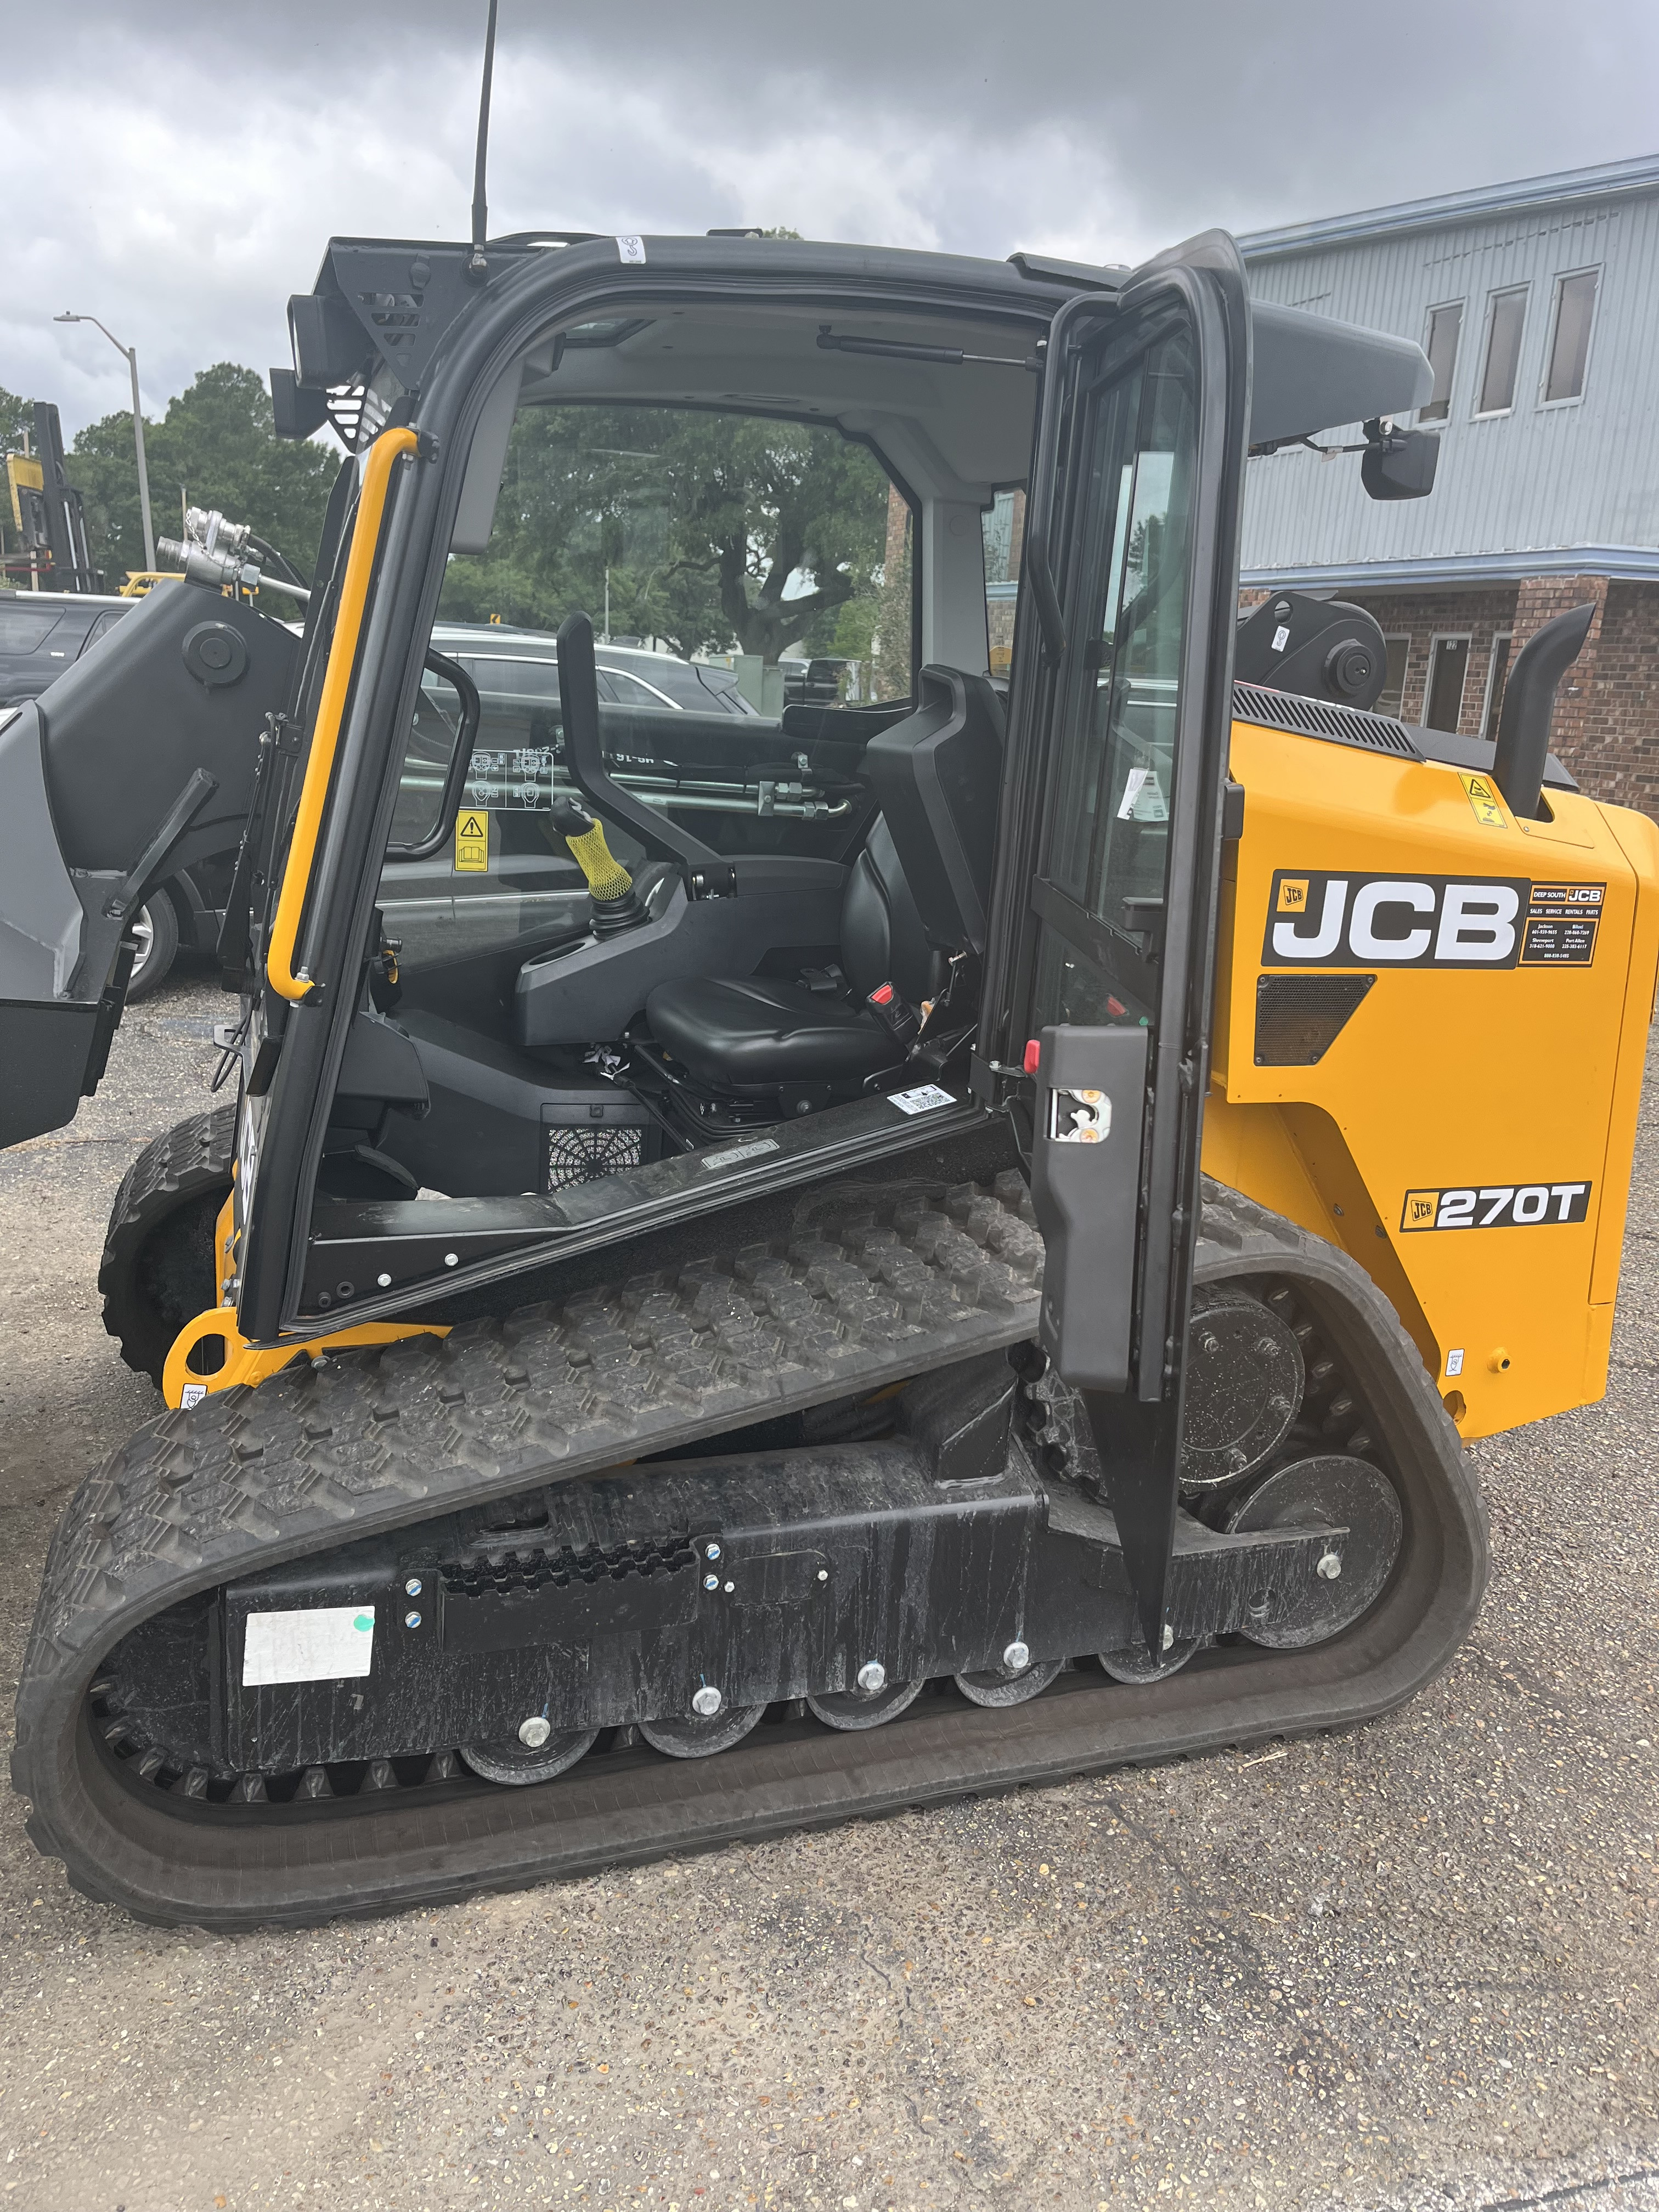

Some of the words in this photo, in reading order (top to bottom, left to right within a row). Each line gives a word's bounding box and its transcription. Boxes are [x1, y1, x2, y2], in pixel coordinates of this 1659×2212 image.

[1286, 887, 1302, 904] JCB
[1569, 890, 1600, 901] JCB
[1272, 880, 1519, 960] JCB
[1413, 1202, 1431, 1219] JCB
[1437, 1184, 1585, 1227] 270T
